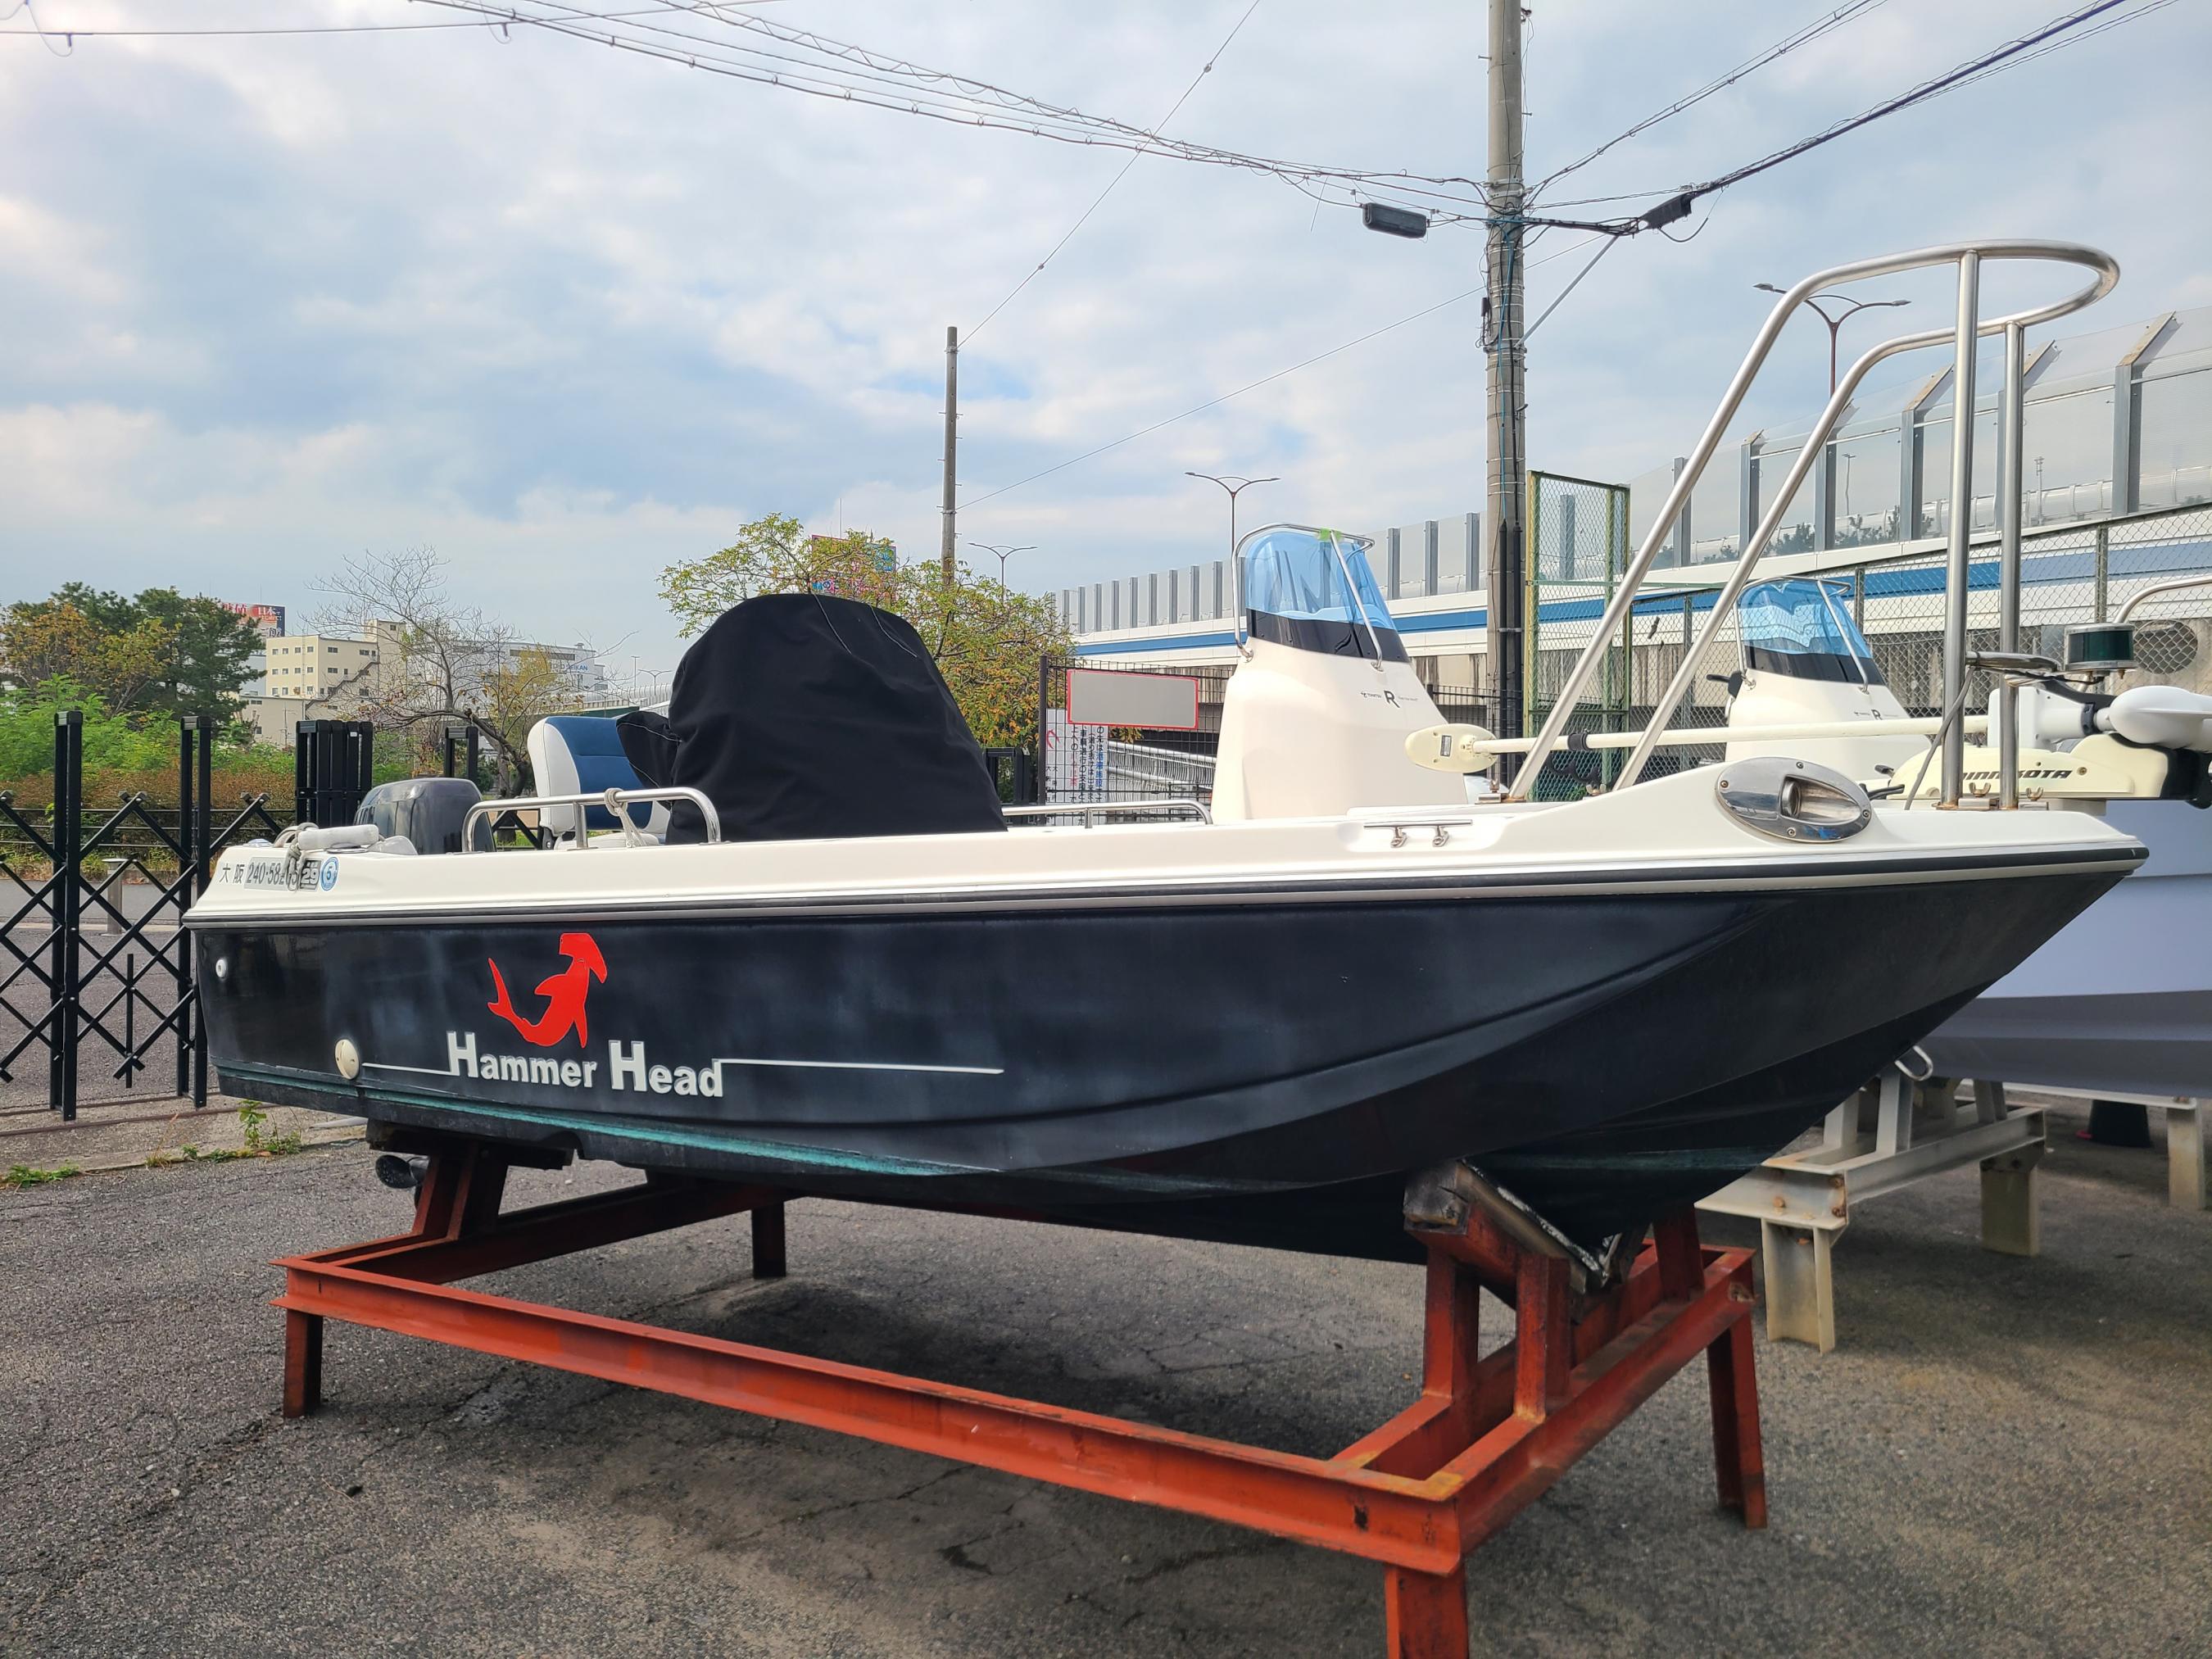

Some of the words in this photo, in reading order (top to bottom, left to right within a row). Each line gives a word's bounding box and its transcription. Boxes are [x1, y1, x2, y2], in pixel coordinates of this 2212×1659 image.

[219, 863, 246, 884] 大阪
[300, 868, 320, 885] 29
[446, 1031, 597, 1089] Hammer
[608, 1039, 724, 1098] Head
